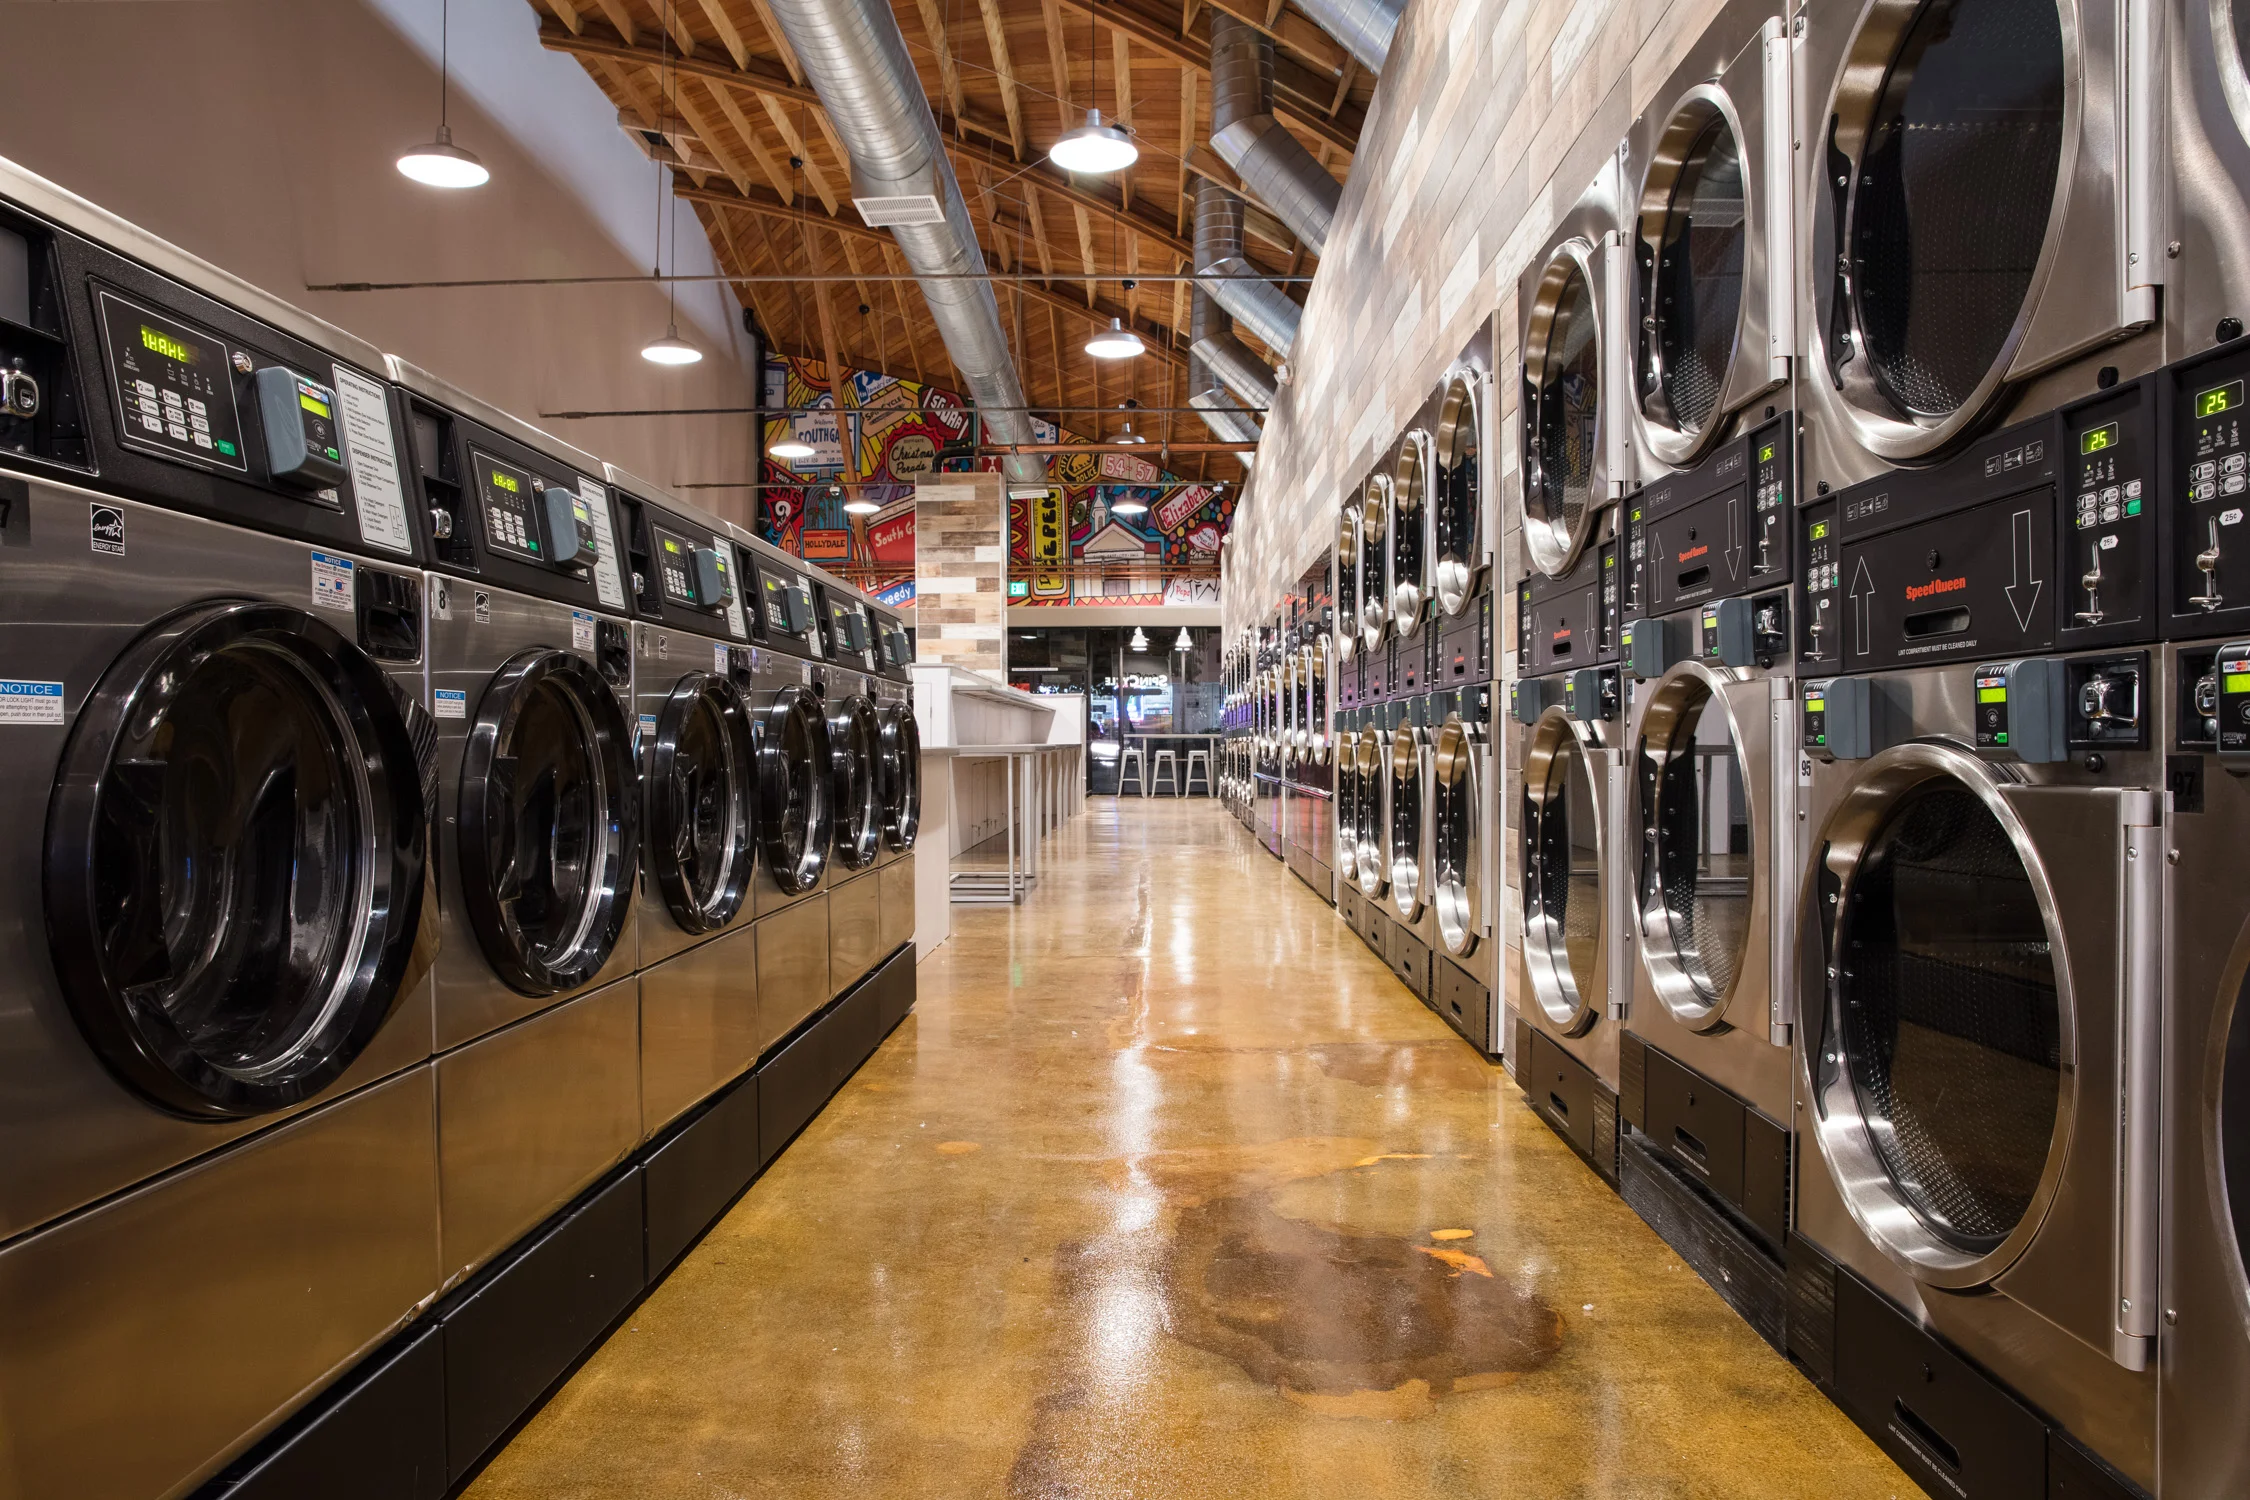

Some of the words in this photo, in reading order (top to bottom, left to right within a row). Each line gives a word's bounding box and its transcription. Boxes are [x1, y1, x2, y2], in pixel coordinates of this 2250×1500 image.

[2206, 392, 2226, 414] 25
[2091, 431, 2107, 450] 25
[891, 444, 934, 461] Christmas
[895, 462, 926, 475] Parade
[1076, 465, 1097, 482] POLICE
[2224, 512, 2238, 522] 25¢
[875, 524, 904, 548] South
[1815, 525, 1825, 538] 25
[93, 542, 111, 551] ENERGY
[111, 543, 124, 553] STAR
[805, 540, 845, 549] HOLLYDALE
[324, 556, 342, 566] NOTICE
[1012, 584, 1026, 595] EXIT
[1906, 581, 1934, 601] Speed
[1935, 577, 1966, 593] Queen
[439, 590, 446, 609] 8
[1906, 645, 1931, 654] COMPARTMENT
[1948, 641, 1965, 649] CLEANED
[0, 684, 53, 695] NOTICE
[440, 691, 461, 699] NOTICE
[1801, 760, 1811, 776] 95
[2173, 771, 2196, 797] 97
